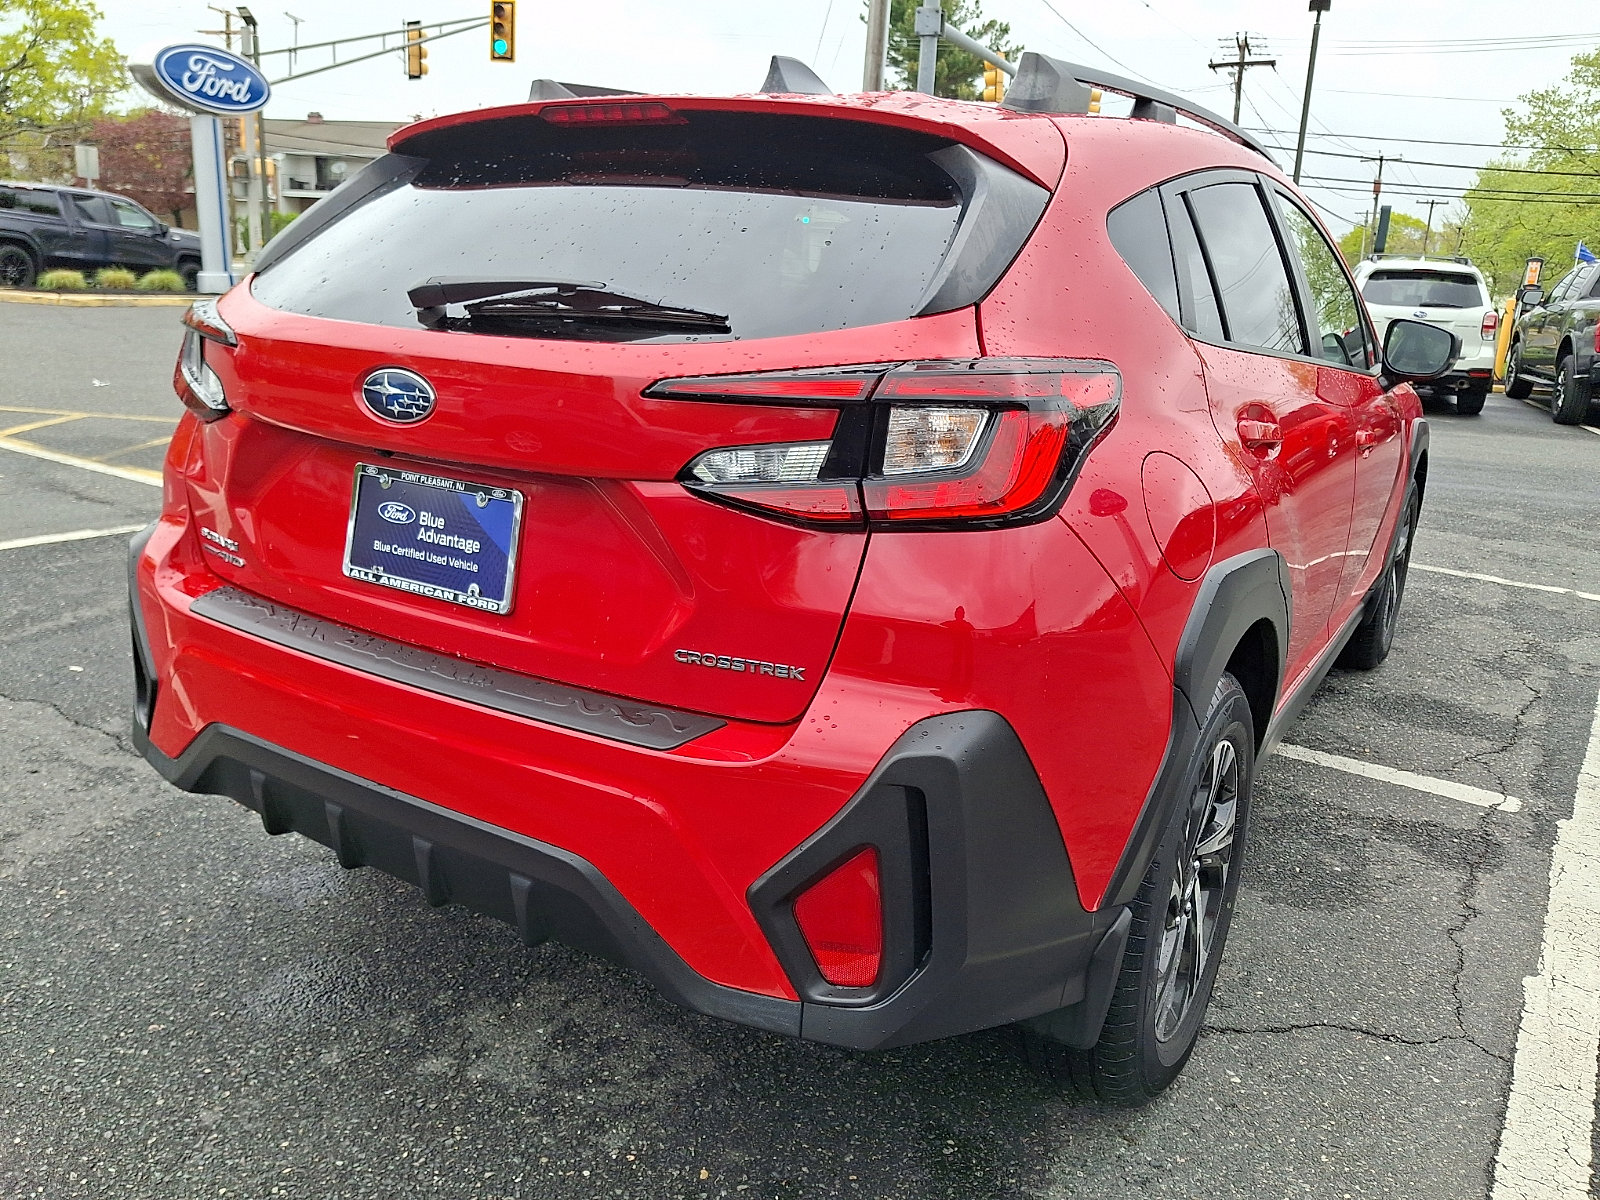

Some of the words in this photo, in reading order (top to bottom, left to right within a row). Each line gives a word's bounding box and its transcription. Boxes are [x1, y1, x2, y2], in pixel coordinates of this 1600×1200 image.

[182, 55, 252, 103] Ford
[401, 472, 420, 484] POINT
[420, 475, 456, 490] PLEASANT,
[456, 482, 465, 491] NJ
[384, 504, 408, 522] Ford
[419, 511, 445, 529] Blue
[417, 528, 480, 554] Advantage
[373, 540, 391, 553] Blue
[391, 544, 425, 561] Certified
[426, 551, 447, 566] Used
[448, 557, 478, 573] Vehicle
[349, 569, 377, 583] ALL
[379, 575, 454, 601] AMERICAN
[458, 595, 499, 612] FORD
[674, 649, 807, 681] CROSSTREK
